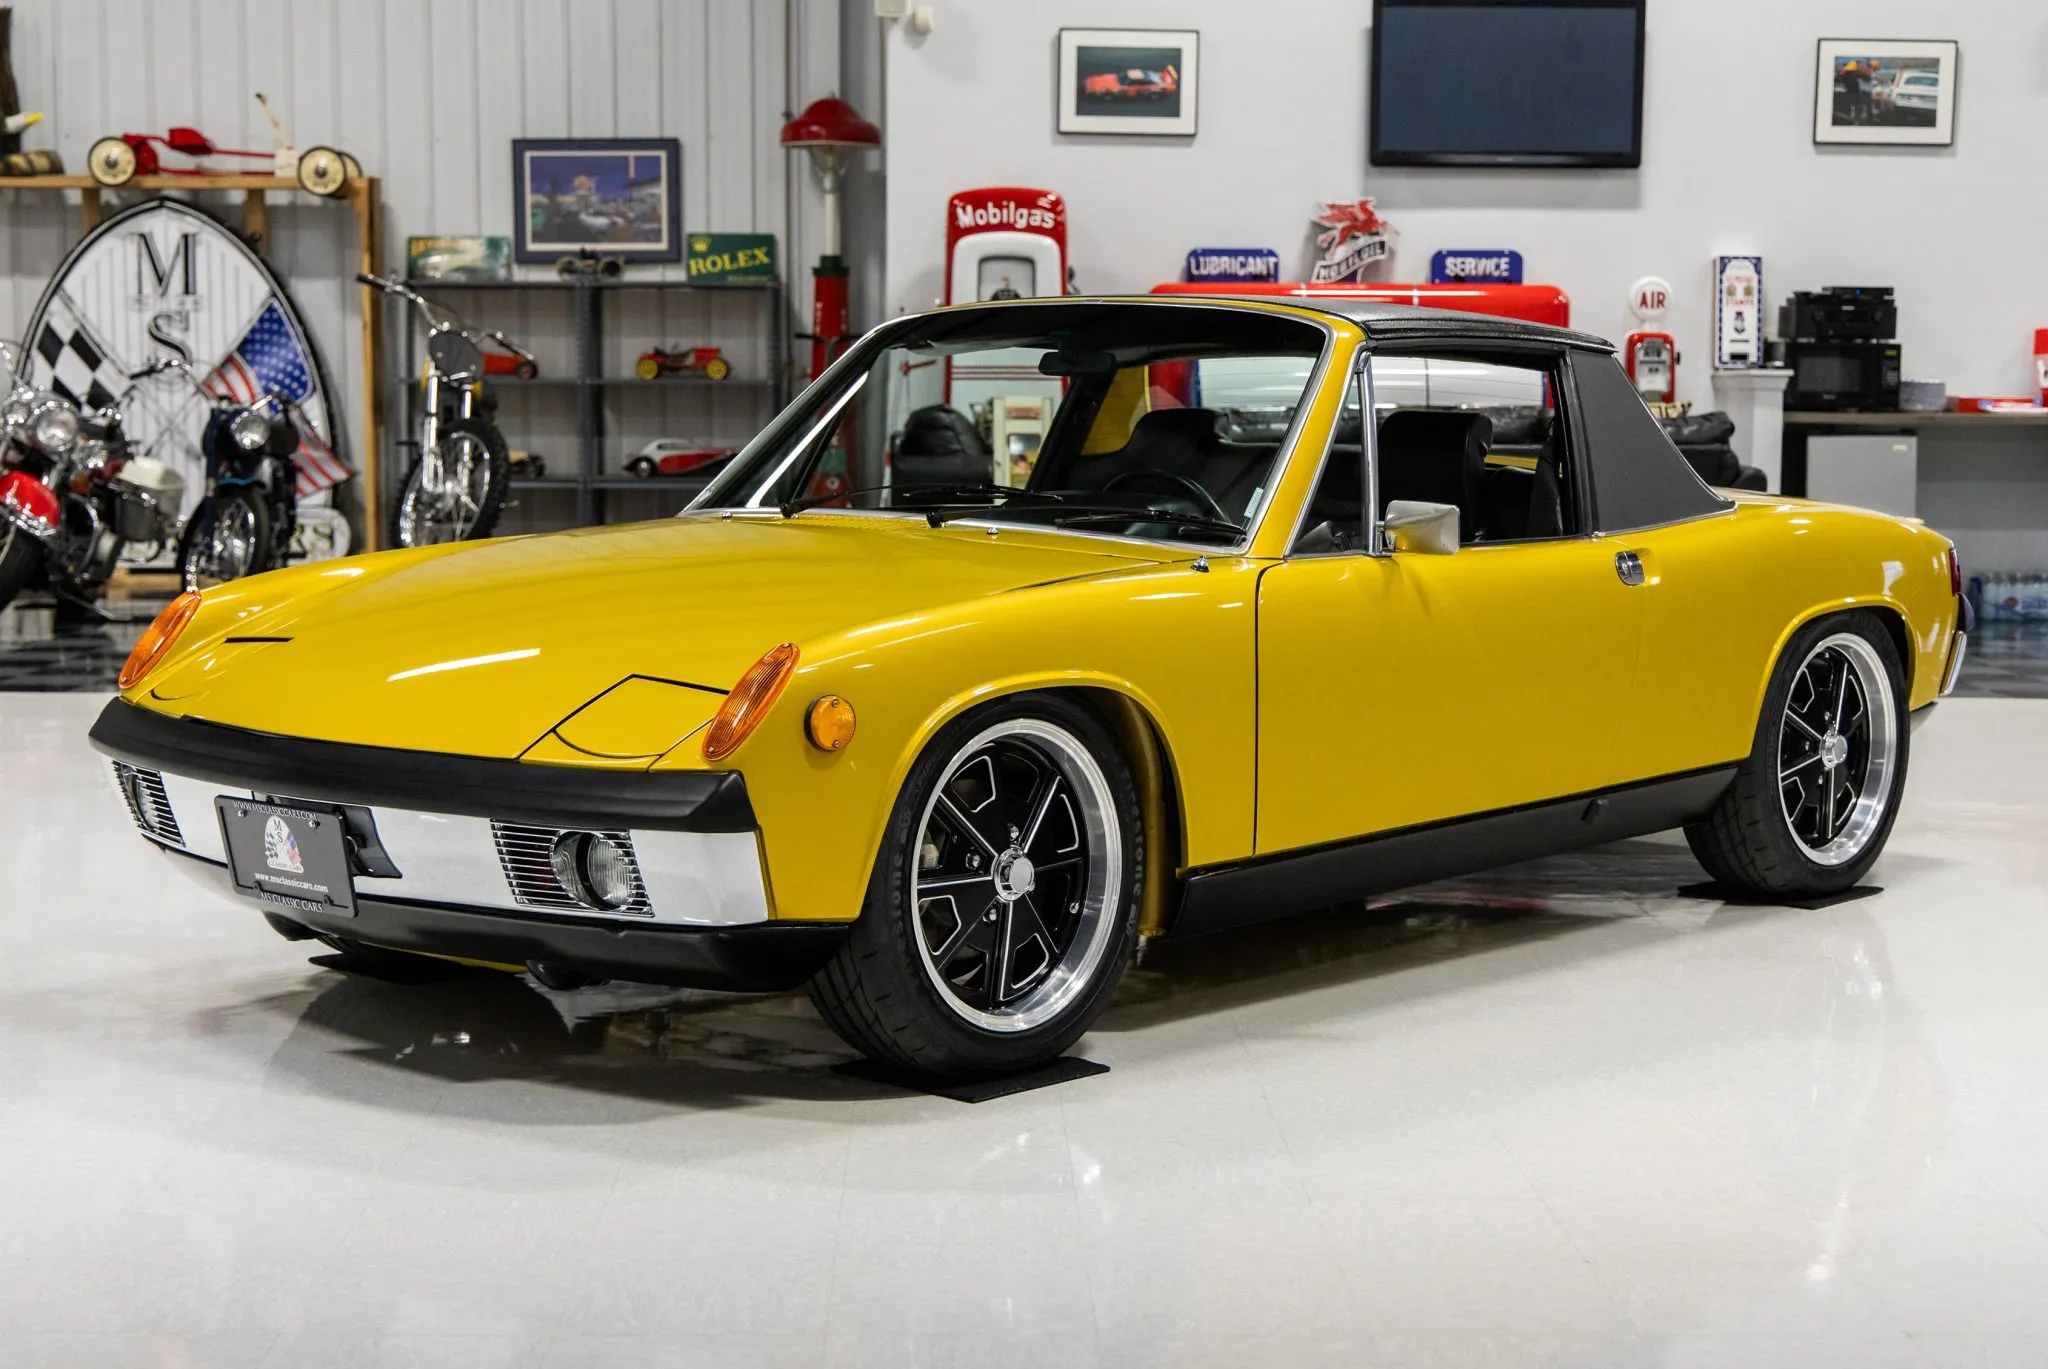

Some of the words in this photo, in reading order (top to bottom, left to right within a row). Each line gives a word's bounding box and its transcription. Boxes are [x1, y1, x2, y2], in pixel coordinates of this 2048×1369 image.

[956, 200, 1056, 229] Mobilgas
[689, 246, 770, 277] ROLEX
[1189, 255, 1278, 276] LUBRICANT
[1444, 256, 1510, 277] SERVICE
[1639, 291, 1666, 309] AIR
[254, 872, 329, 893] www.msclassiccars.com
[260, 892, 271, 902] MS
[273, 894, 301, 909] CLASSIC
[302, 900, 323, 912] CARS
